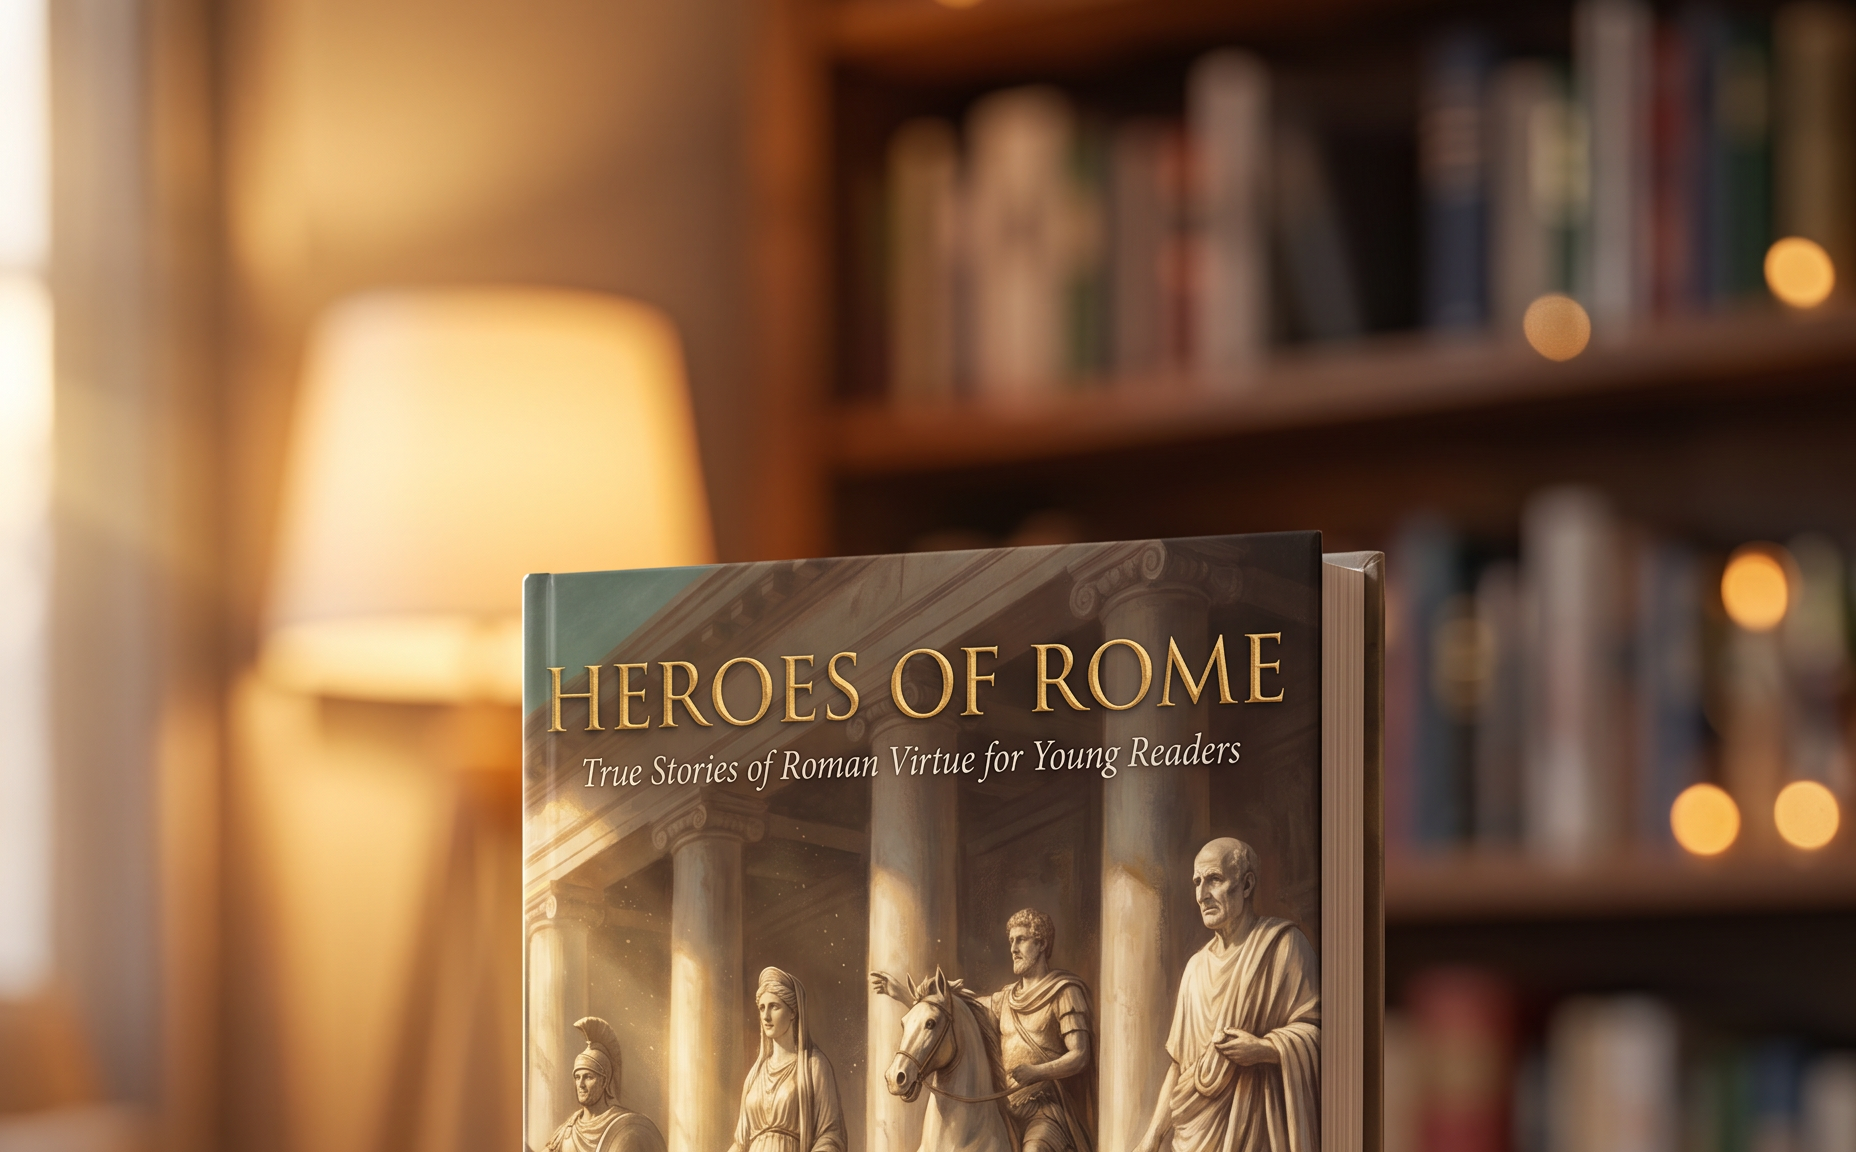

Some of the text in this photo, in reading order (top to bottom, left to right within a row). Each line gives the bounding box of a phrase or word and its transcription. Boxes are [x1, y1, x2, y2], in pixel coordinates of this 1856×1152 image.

[546, 631, 1286, 733] HEROES OF ROME
[583, 732, 1242, 793] True Stories of Roman Virtue for Young Readers
